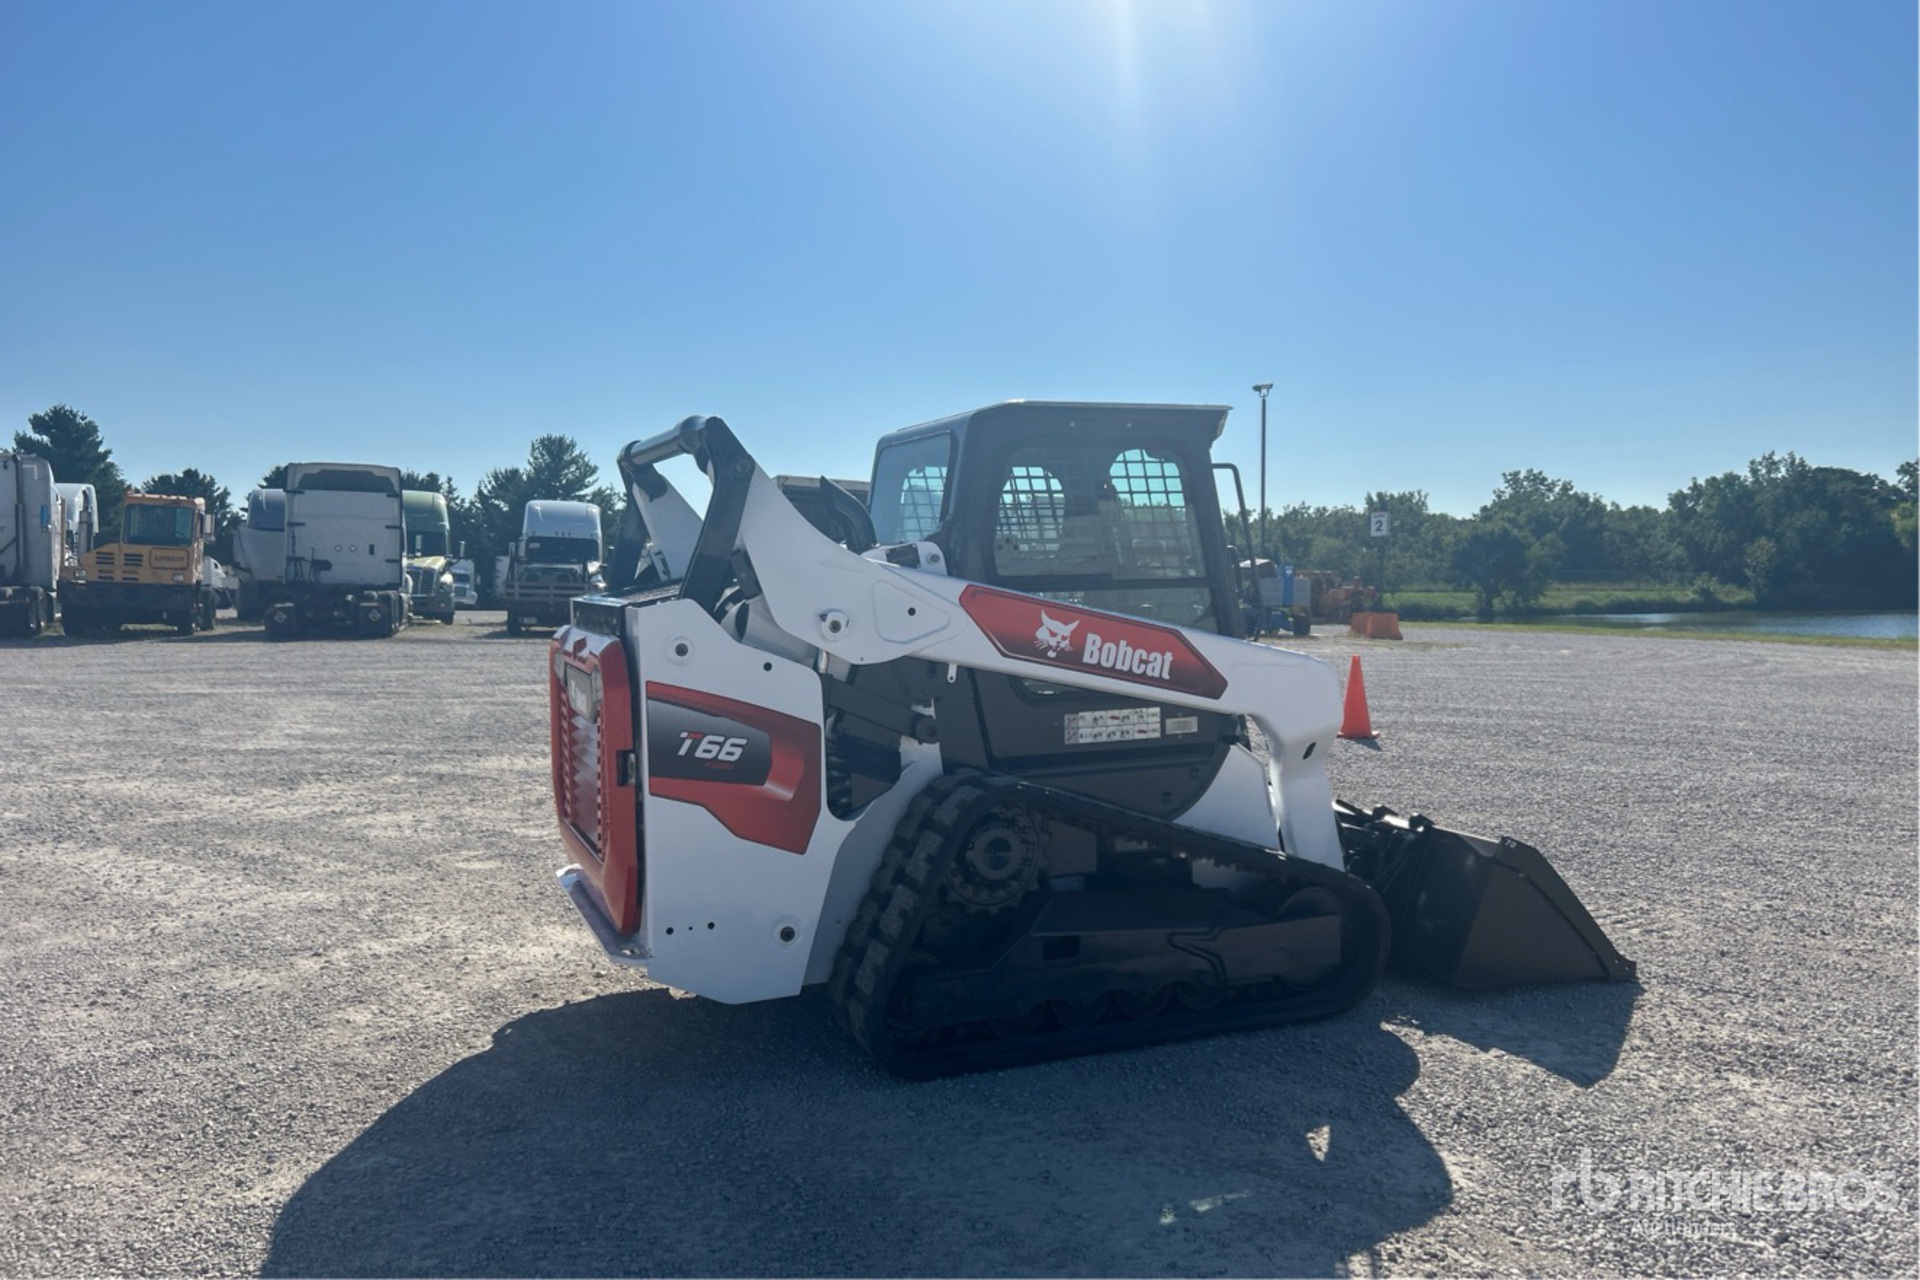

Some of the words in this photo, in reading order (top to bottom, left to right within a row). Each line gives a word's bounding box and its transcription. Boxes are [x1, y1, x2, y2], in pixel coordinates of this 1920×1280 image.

[1375, 520, 1384, 532] 2
[153, 555, 185, 563] CAPACITY
[1082, 632, 1174, 680] Bobcat
[677, 731, 749, 762] T66
